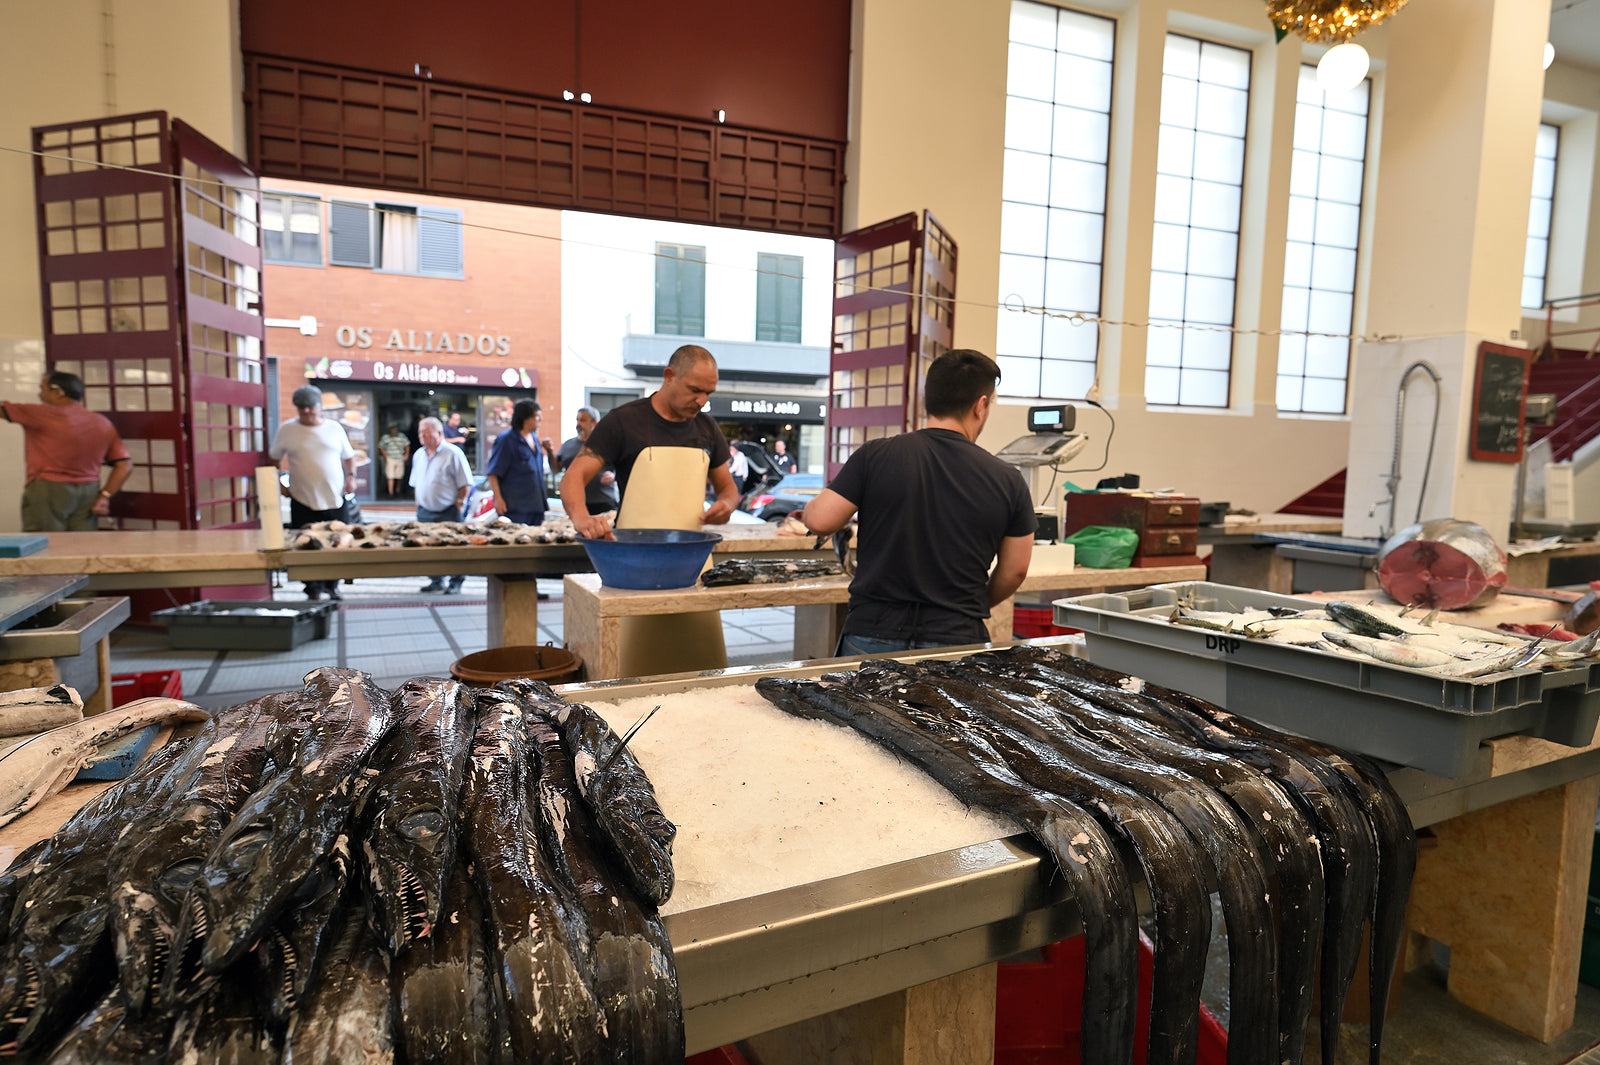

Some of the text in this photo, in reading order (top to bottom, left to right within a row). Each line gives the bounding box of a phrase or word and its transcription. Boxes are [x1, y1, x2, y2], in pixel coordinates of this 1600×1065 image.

[335, 325, 511, 356] OS ALIADOS
[373, 361, 394, 380] Os
[398, 362, 456, 384] Aliados
[731, 400, 752, 413] BAR
[1205, 634, 1241, 654] DRP
